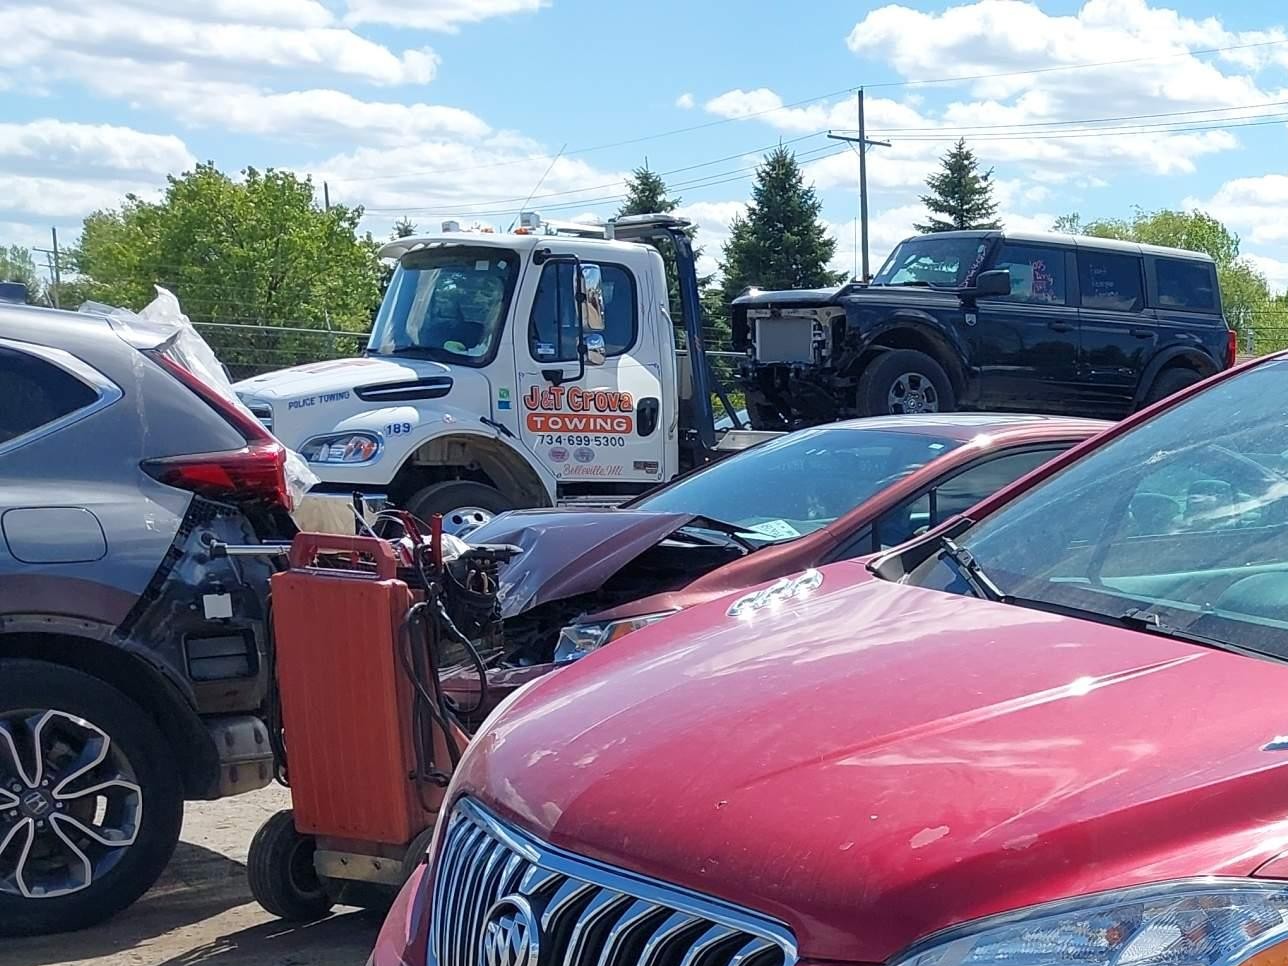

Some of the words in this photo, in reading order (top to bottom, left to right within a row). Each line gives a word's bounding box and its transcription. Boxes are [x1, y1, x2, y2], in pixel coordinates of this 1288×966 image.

[288, 397, 316, 410] POLICE
[319, 391, 350, 404] TOWING
[524, 385, 565, 411] J&T
[567, 386, 634, 412] Crova
[386, 422, 411, 435] 189
[533, 416, 628, 431] TOWING
